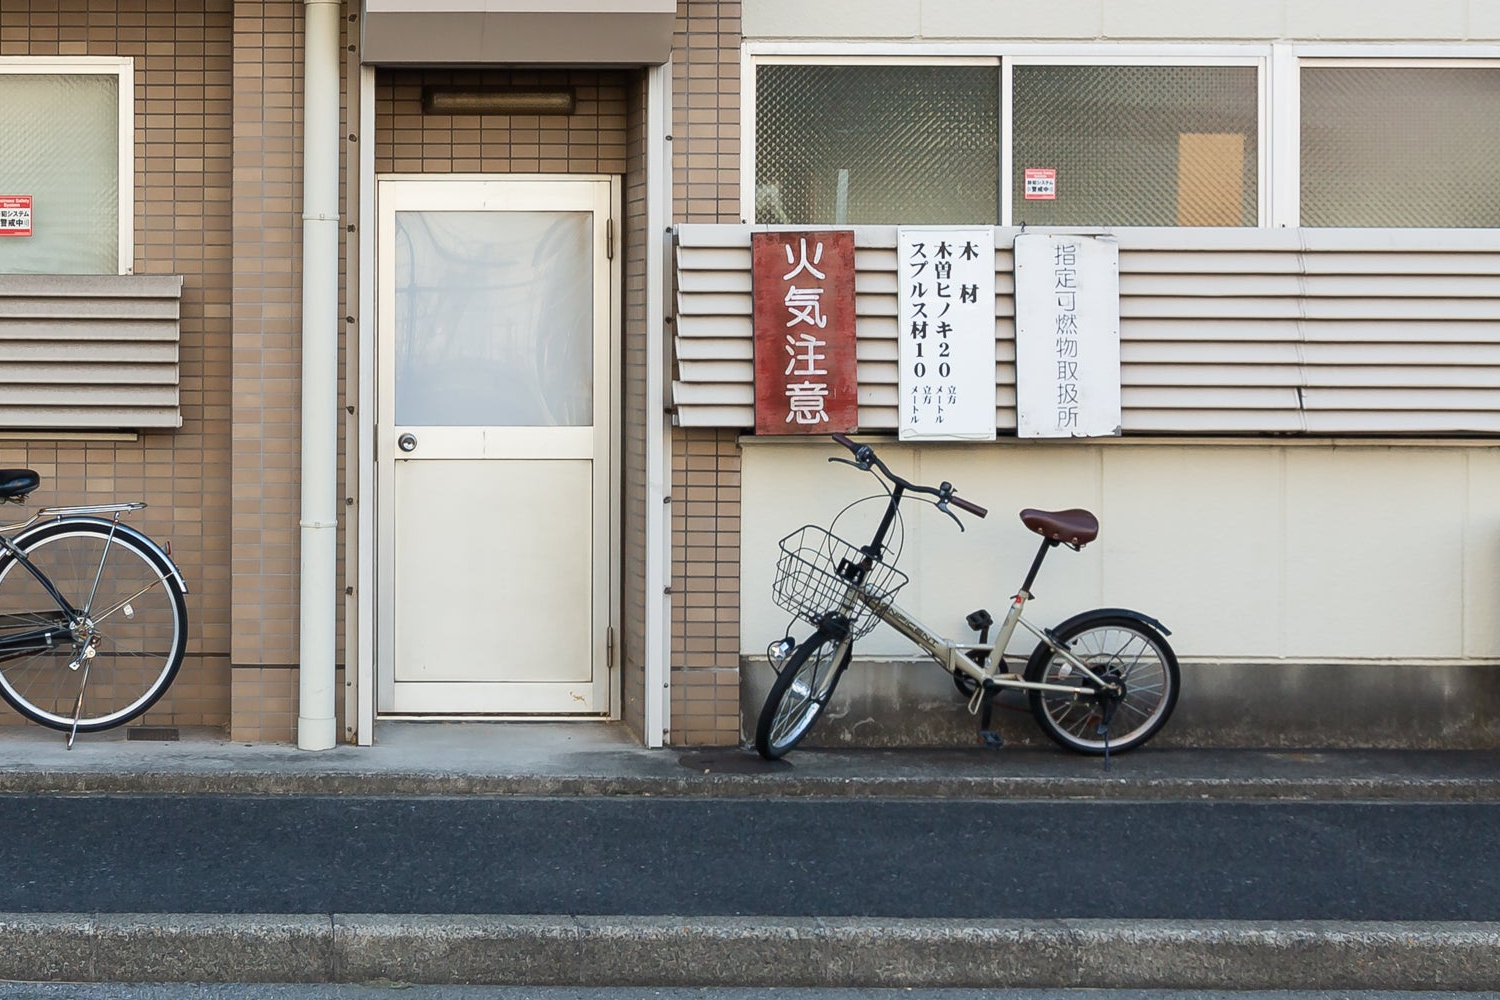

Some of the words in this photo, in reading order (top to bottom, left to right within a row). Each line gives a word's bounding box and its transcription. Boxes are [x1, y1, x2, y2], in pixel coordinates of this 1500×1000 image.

[783, 237, 830, 426] 火気注意
[958, 241, 979, 304] 木材
[1054, 244, 1079, 429] 指定可燃物取扱所
